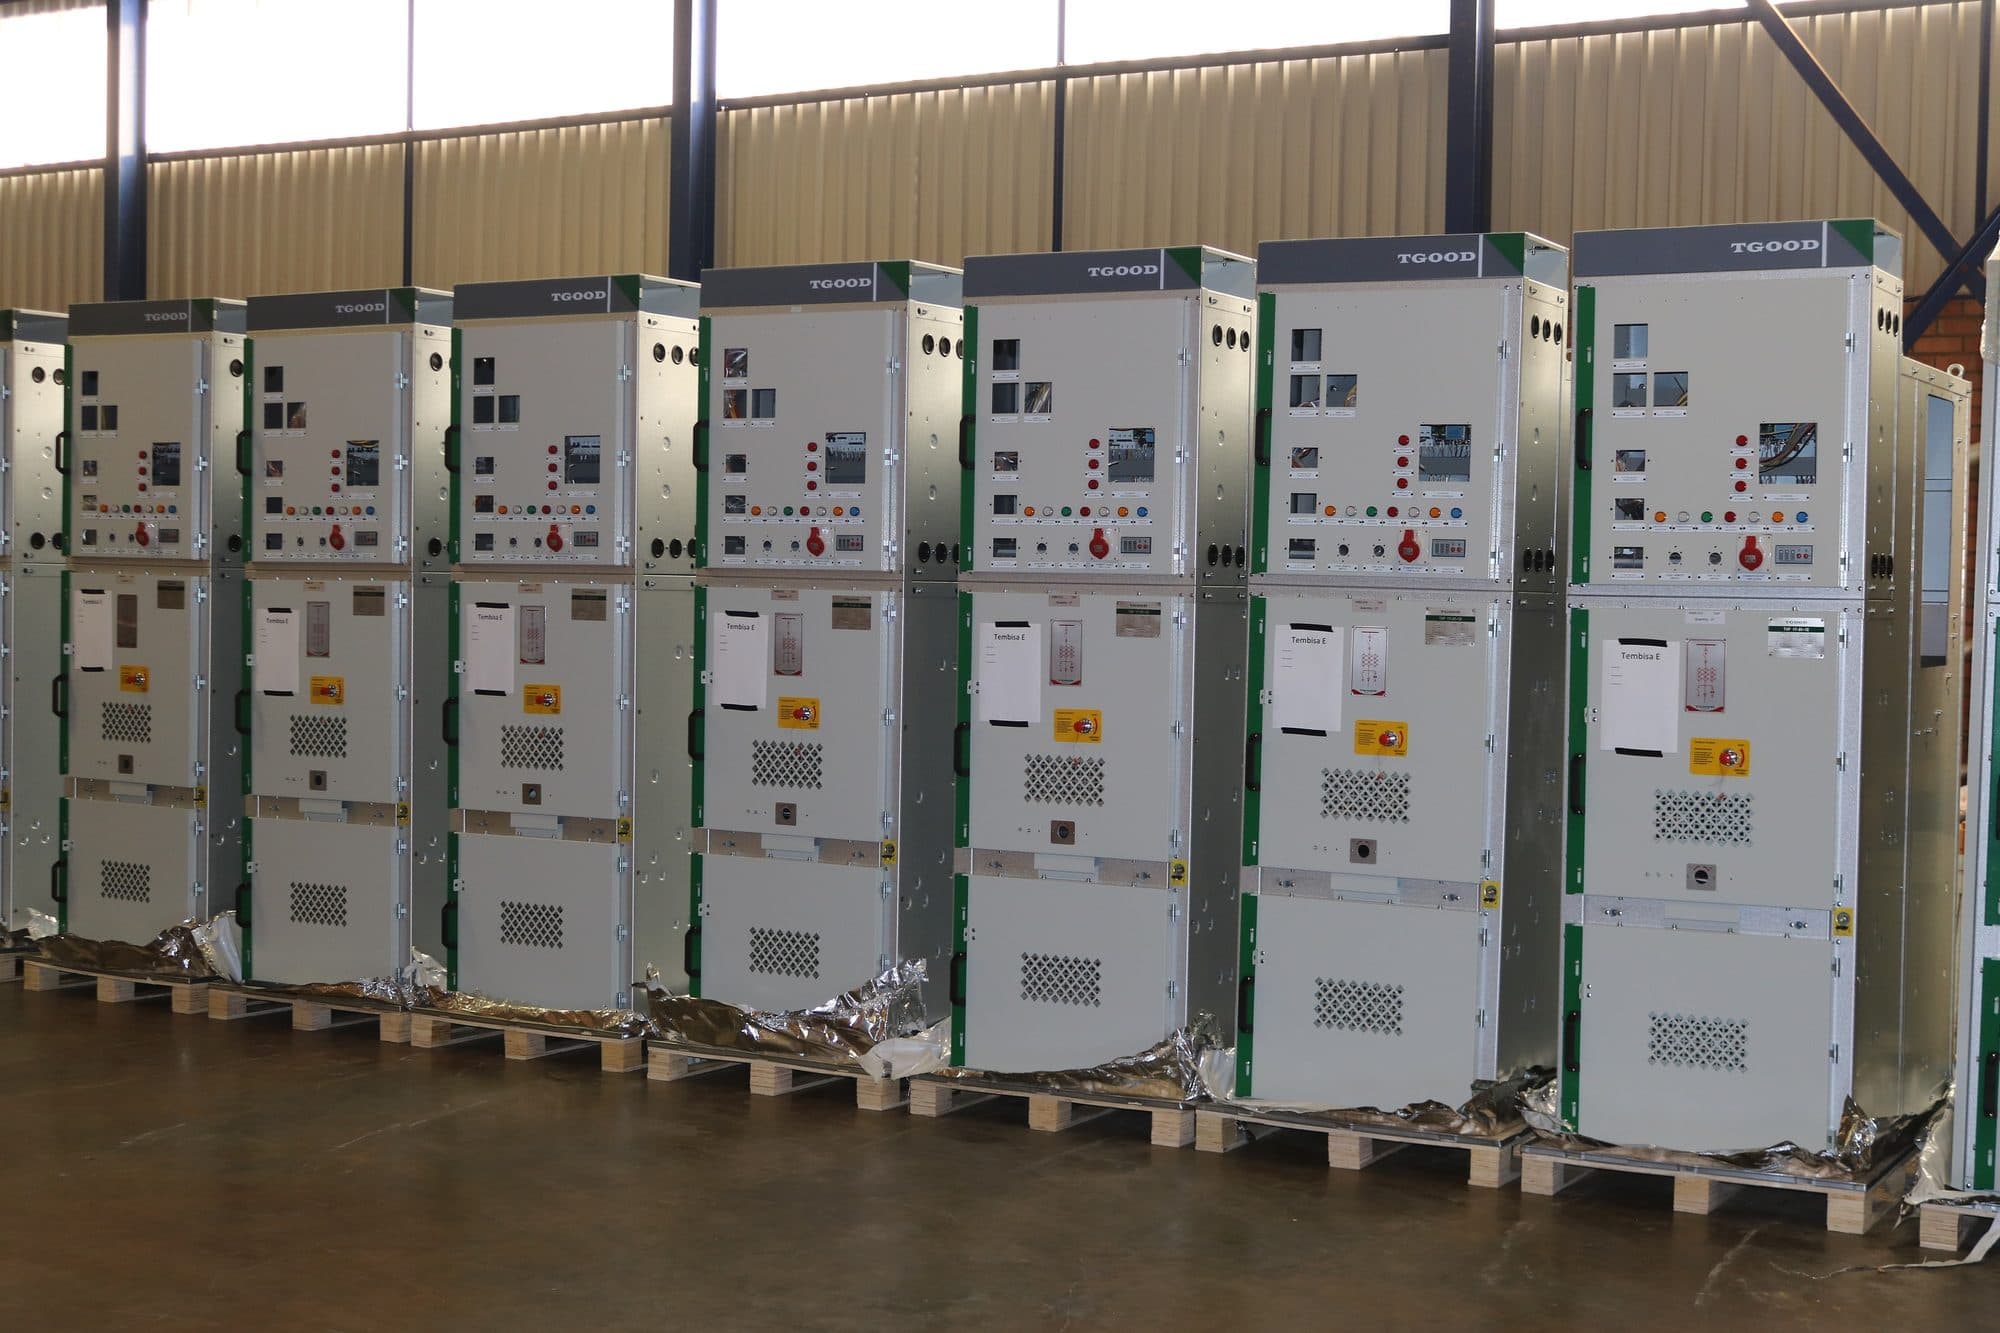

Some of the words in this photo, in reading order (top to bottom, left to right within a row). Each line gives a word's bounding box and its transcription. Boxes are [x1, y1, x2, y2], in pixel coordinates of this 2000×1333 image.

[1730, 239, 1820, 253] TGOOD
[1397, 252, 1476, 264] TGOOD
[1088, 265, 1158, 277] TGOOD
[809, 278, 872, 289] TGOOD
[551, 291, 606, 302] TGOOD
[335, 303, 385, 313] TGOOD
[144, 312, 187, 321] TGOOD
[1291, 636, 1320, 644] Tembisa
[1621, 651, 1654, 660] Tembisa
[1655, 652, 1661, 661] E
